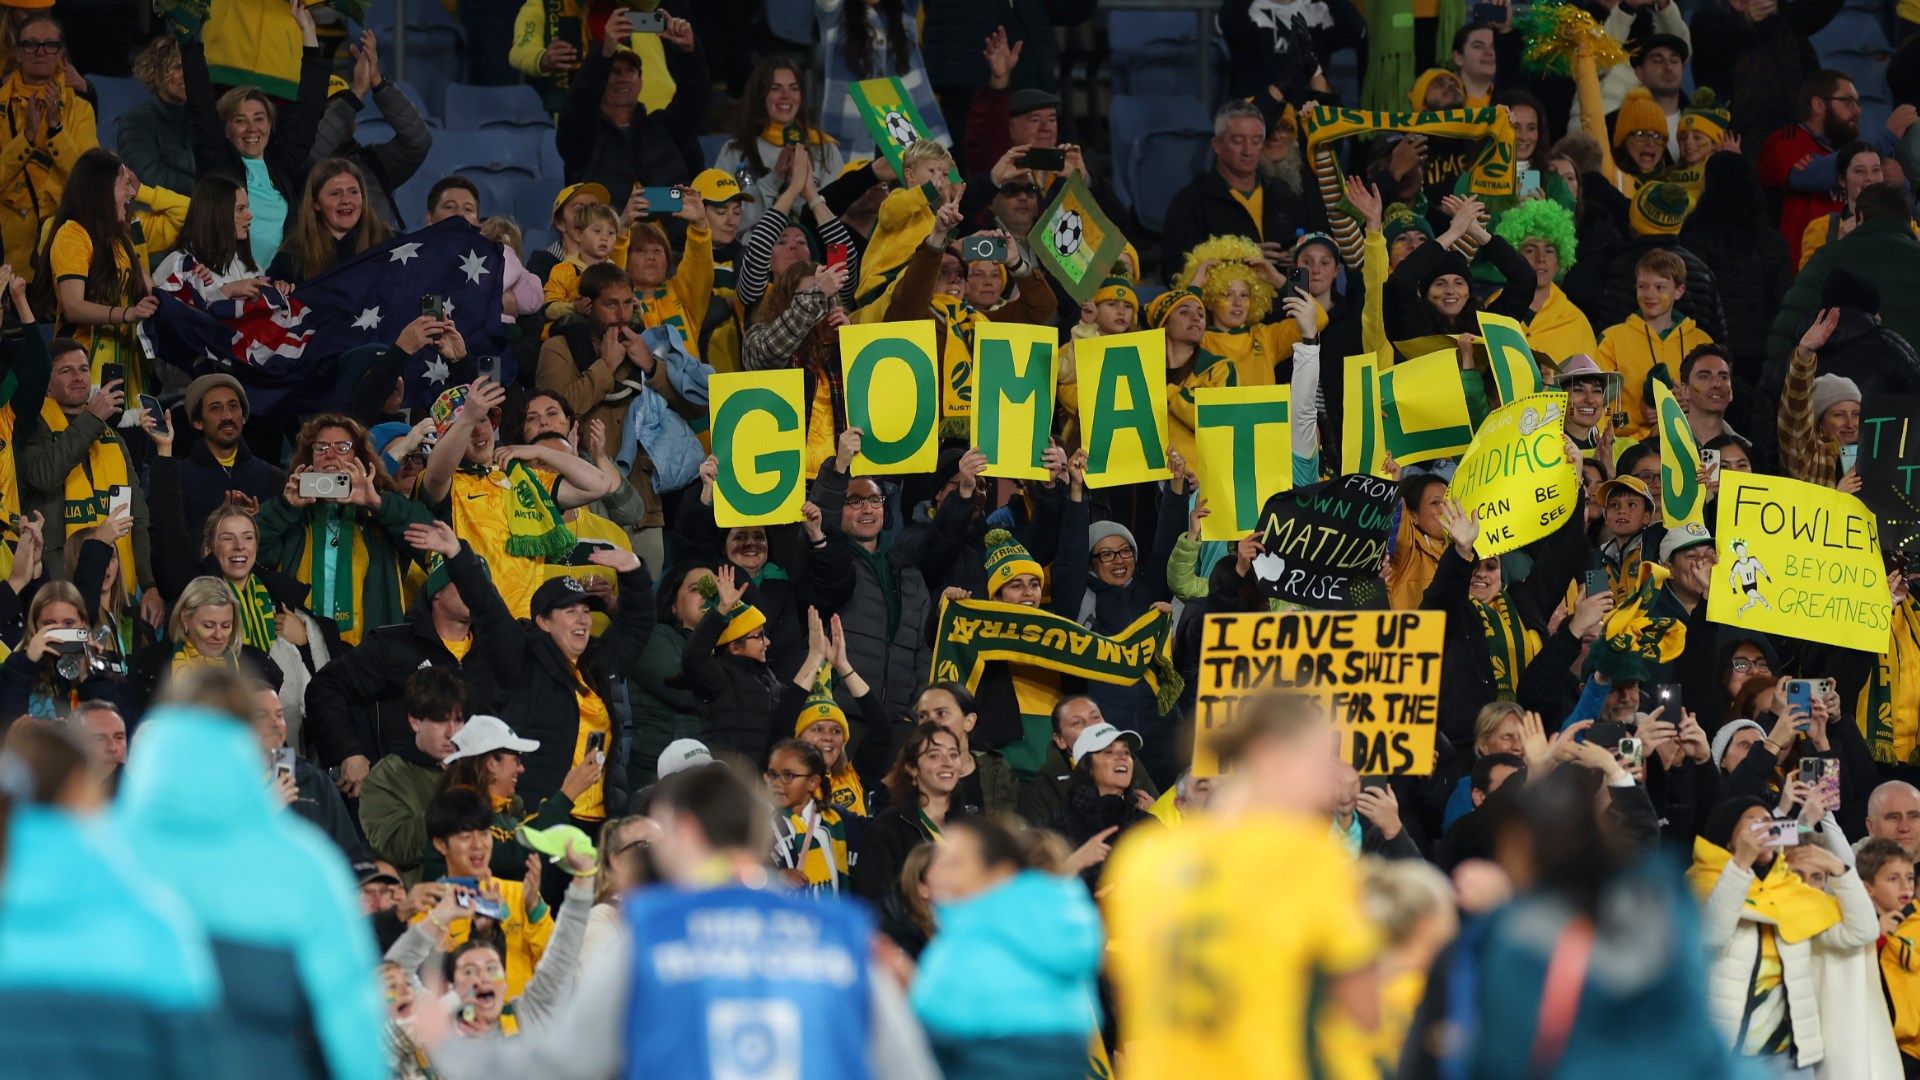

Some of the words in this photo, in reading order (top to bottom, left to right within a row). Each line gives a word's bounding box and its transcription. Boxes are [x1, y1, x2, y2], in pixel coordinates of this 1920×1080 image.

[1473, 179, 1511, 190] AUSTRALIA
[847, 337, 936, 465] O
[976, 338, 1053, 468] M
[1086, 345, 1166, 475] A
[1379, 371, 1473, 460] L
[711, 387, 801, 516] G
[1197, 400, 1289, 532] T
[1660, 396, 1698, 521] S
[1344, 474, 1400, 504] FROM
[1477, 498, 1511, 521] CAN
[1535, 483, 1561, 504] BE
[1486, 525, 1515, 546] WE
[1539, 503, 1568, 527] SEE
[1733, 485, 1883, 554] FOWLER
[1284, 569, 1349, 601] RISE
[1784, 554, 1878, 589] BEYOND
[1777, 587, 1893, 631] GREATNESS
[1206, 617, 1239, 652] I
[1252, 613, 1358, 650] GAVE
[1376, 613, 1421, 649] UP
[1203, 652, 1338, 689] TAYLOR
[1342, 650, 1441, 685] SWIFT
[1329, 691, 1376, 724] FOR
[1383, 692, 1437, 725] THE
